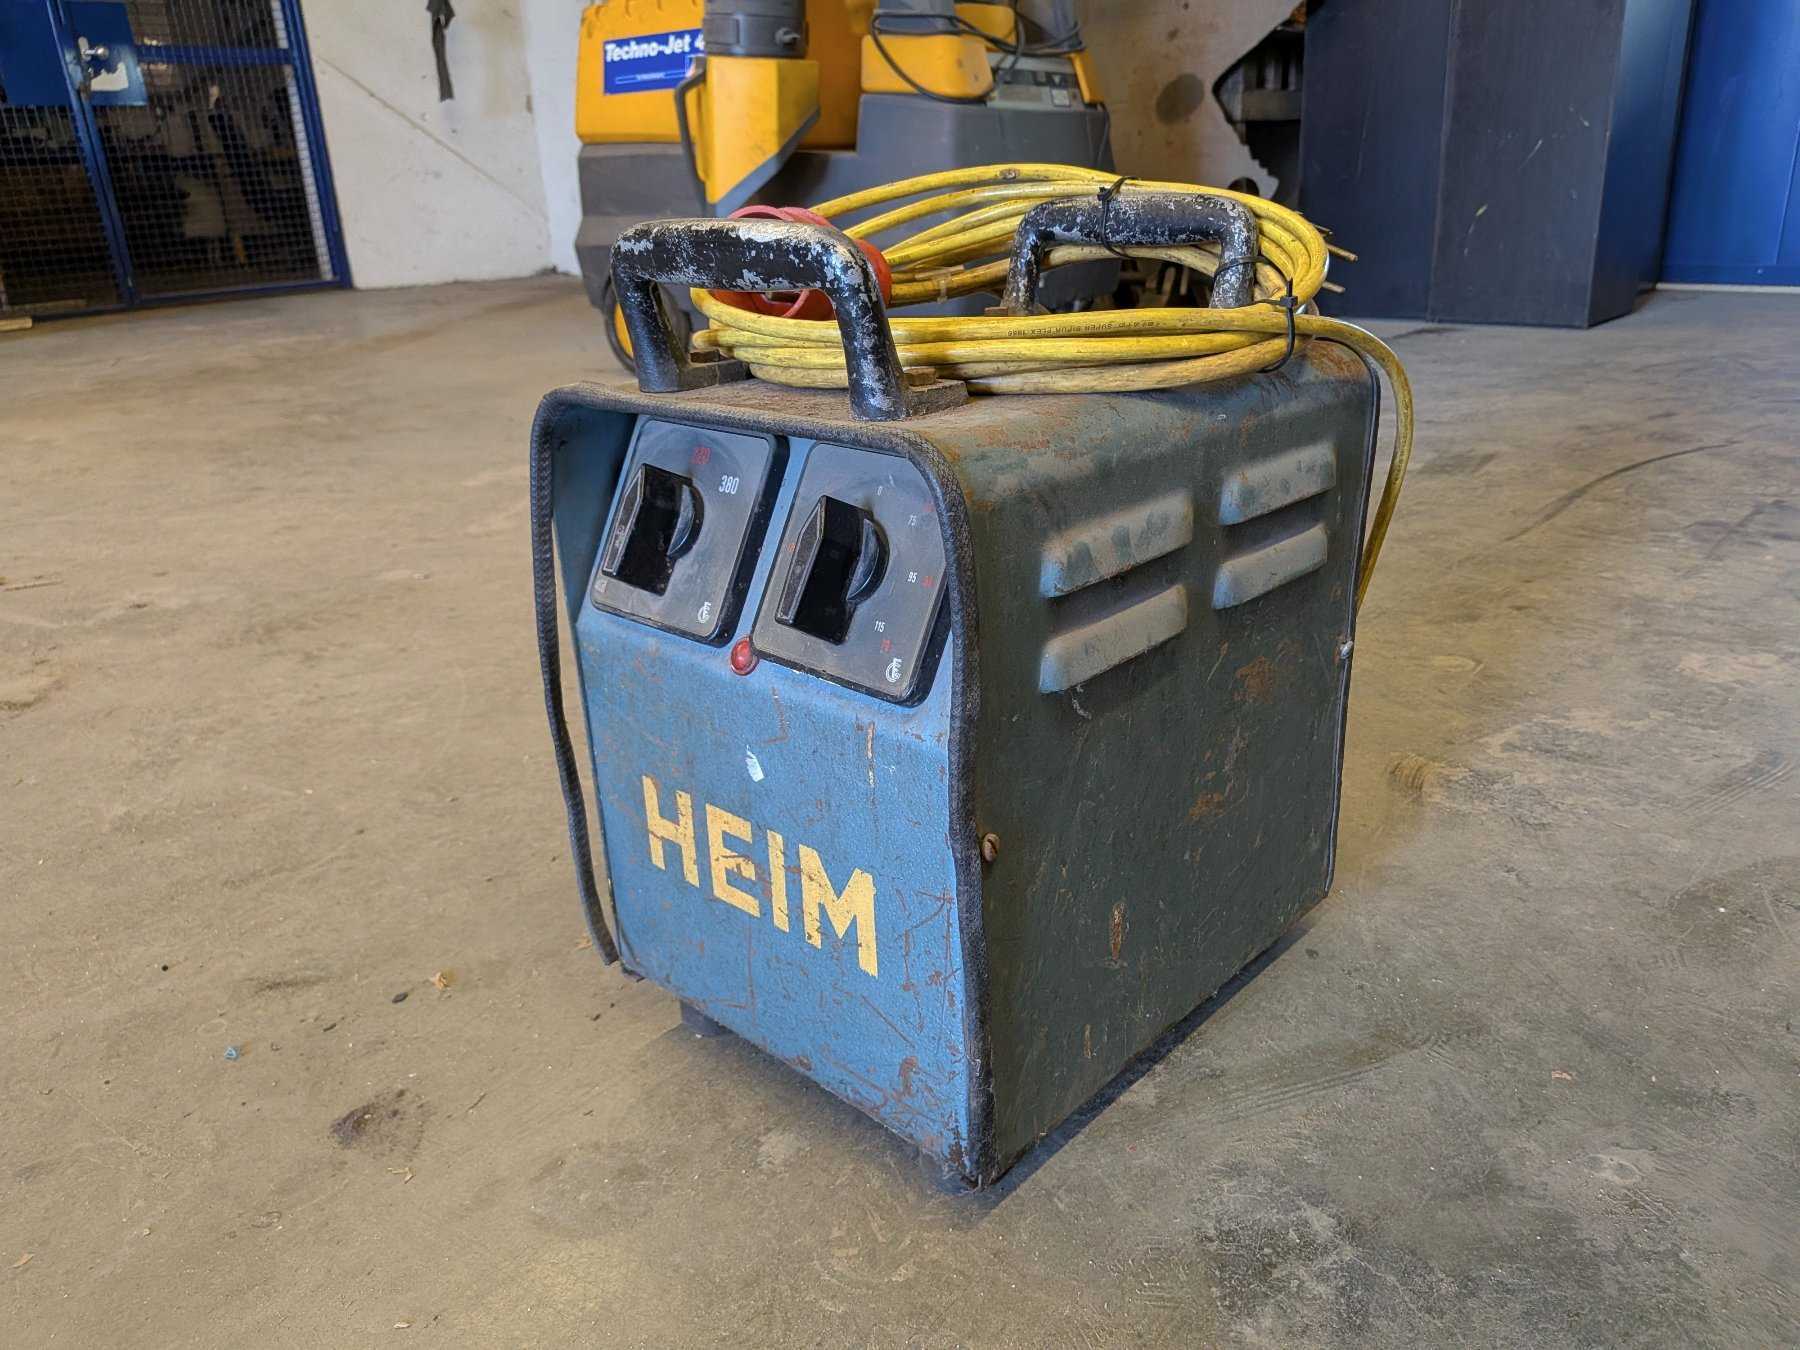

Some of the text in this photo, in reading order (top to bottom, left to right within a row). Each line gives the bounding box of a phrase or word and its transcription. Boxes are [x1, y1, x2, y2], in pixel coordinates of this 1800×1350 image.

[605, 34, 691, 62] Techno-Jet
[719, 474, 740, 495] 380
[907, 515, 917, 526] 75
[907, 571, 918, 583] 95
[874, 620, 886, 633] 115
[643, 775, 879, 979] HEIM
